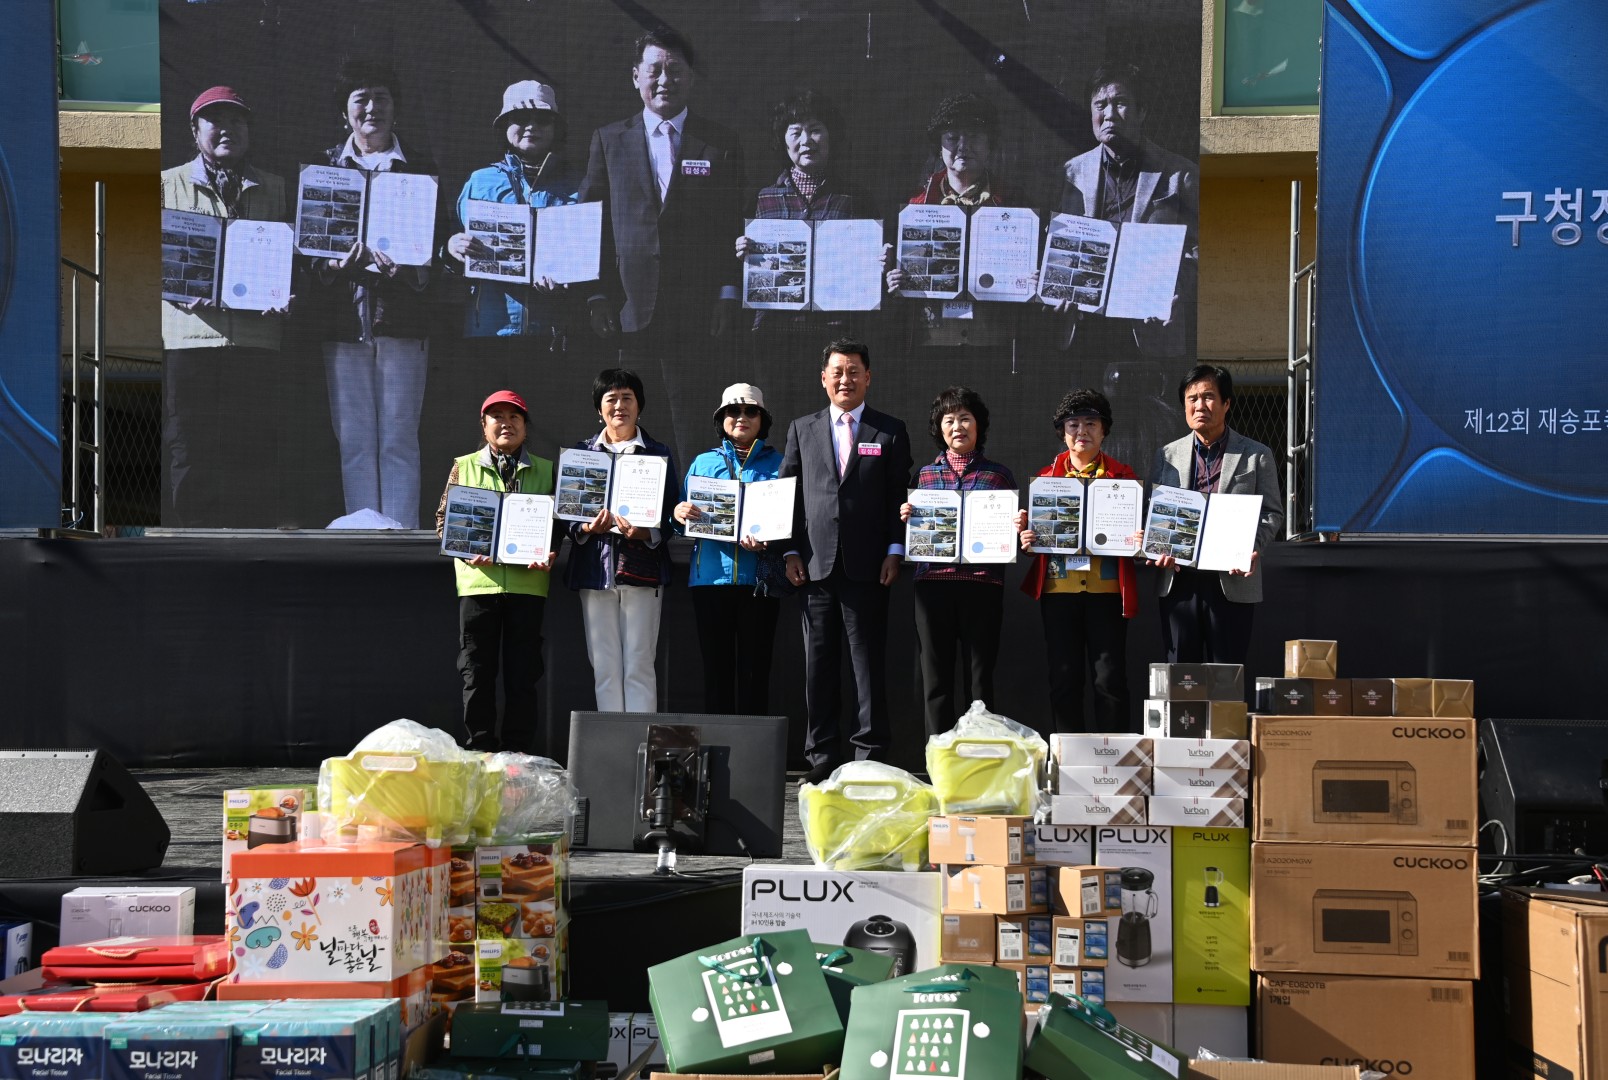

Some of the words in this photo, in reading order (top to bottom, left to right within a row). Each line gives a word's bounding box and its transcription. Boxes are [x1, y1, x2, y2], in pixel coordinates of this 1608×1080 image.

[1464, 407, 1530, 434] 제12회
[1538, 407, 1608, 434] 재송포
[1392, 727, 1466, 739] CUCKOO
[1034, 828, 1089, 843] LUX
[1099, 828, 1168, 844] PLUX
[1193, 832, 1230, 842] PLUX
[1393, 856, 1468, 870] CUCKOO
[751, 879, 855, 902] PLUX
[1269, 995, 1291, 1005] 1개입
[17, 1047, 84, 1065] 모나리자
[129, 1050, 198, 1068] 모나리자
[260, 1046, 327, 1064] 모나리자
[32, 1068, 48, 1076] Facial
[50, 1068, 68, 1076] Tissue
[276, 1068, 292, 1076] Facial
[294, 1068, 312, 1076] Tissue
